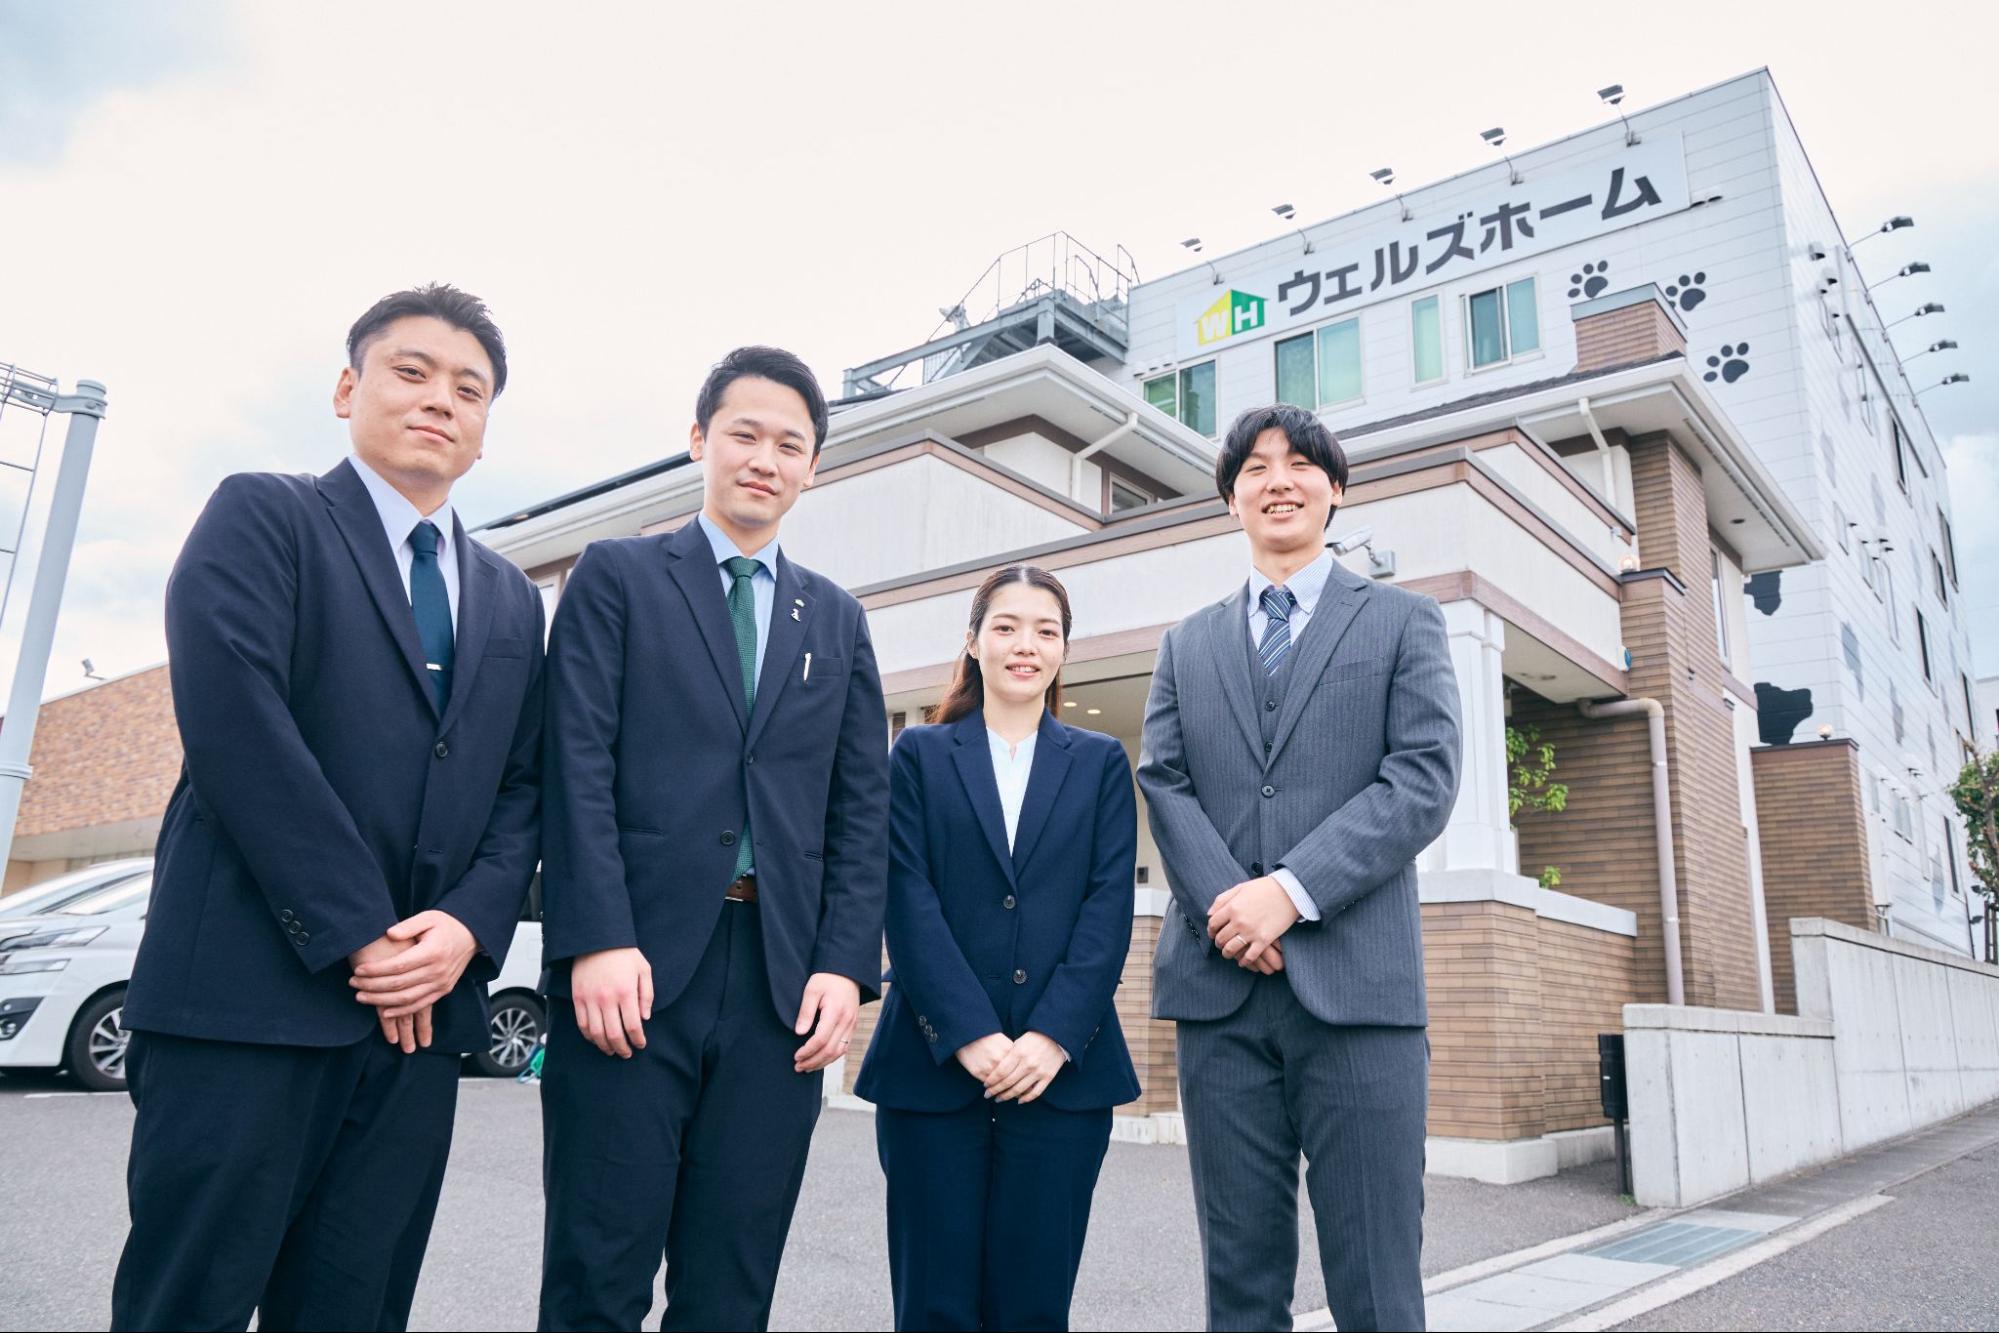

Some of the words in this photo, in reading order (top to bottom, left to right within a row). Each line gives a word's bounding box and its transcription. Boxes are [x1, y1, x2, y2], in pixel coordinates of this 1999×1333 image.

[1278, 166, 1662, 317] ウェルズホーム
[1201, 300, 1258, 340] WH
